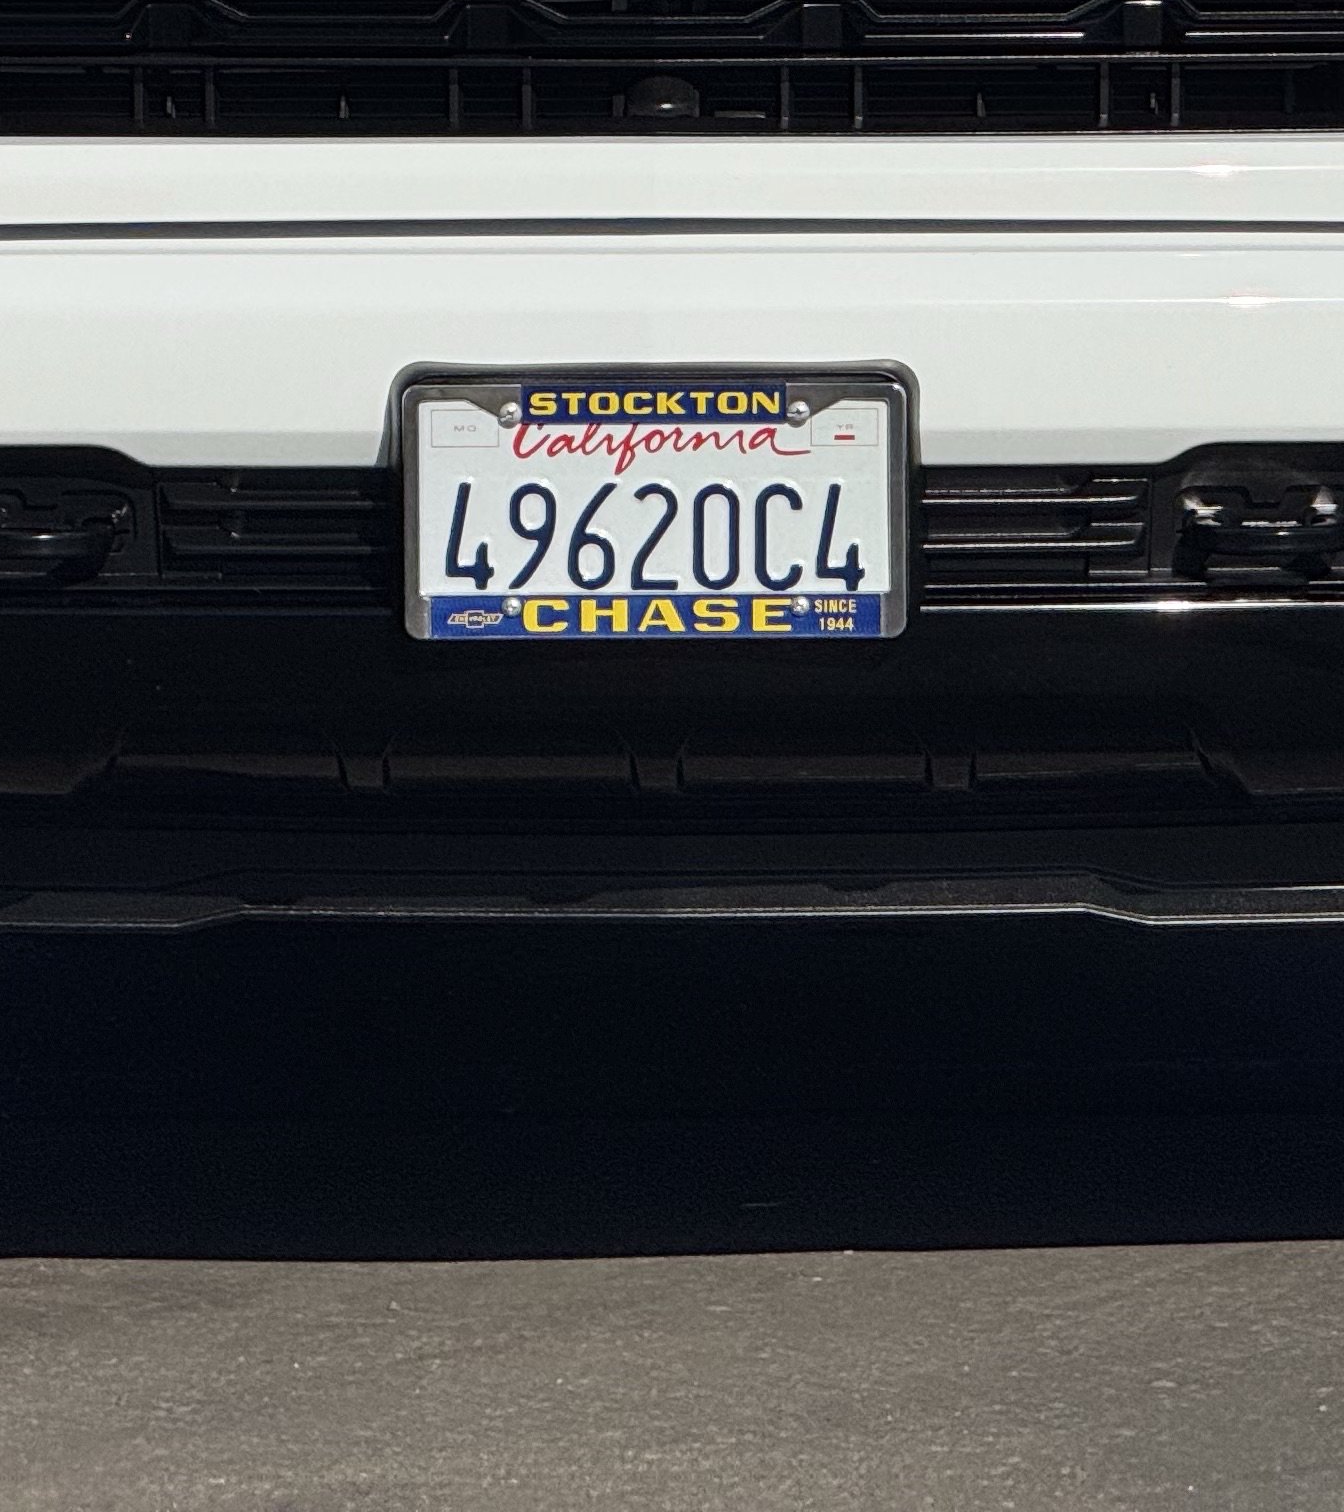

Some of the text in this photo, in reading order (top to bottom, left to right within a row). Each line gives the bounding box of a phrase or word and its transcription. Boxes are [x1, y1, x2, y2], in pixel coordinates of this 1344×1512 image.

[528, 391, 781, 416] STOCKTON
[512, 422, 812, 476] California
[444, 482, 866, 591] 49620C4
[522, 598, 793, 633] CHASE
[814, 599, 857, 614] SINCE
[819, 616, 855, 632] 1944
